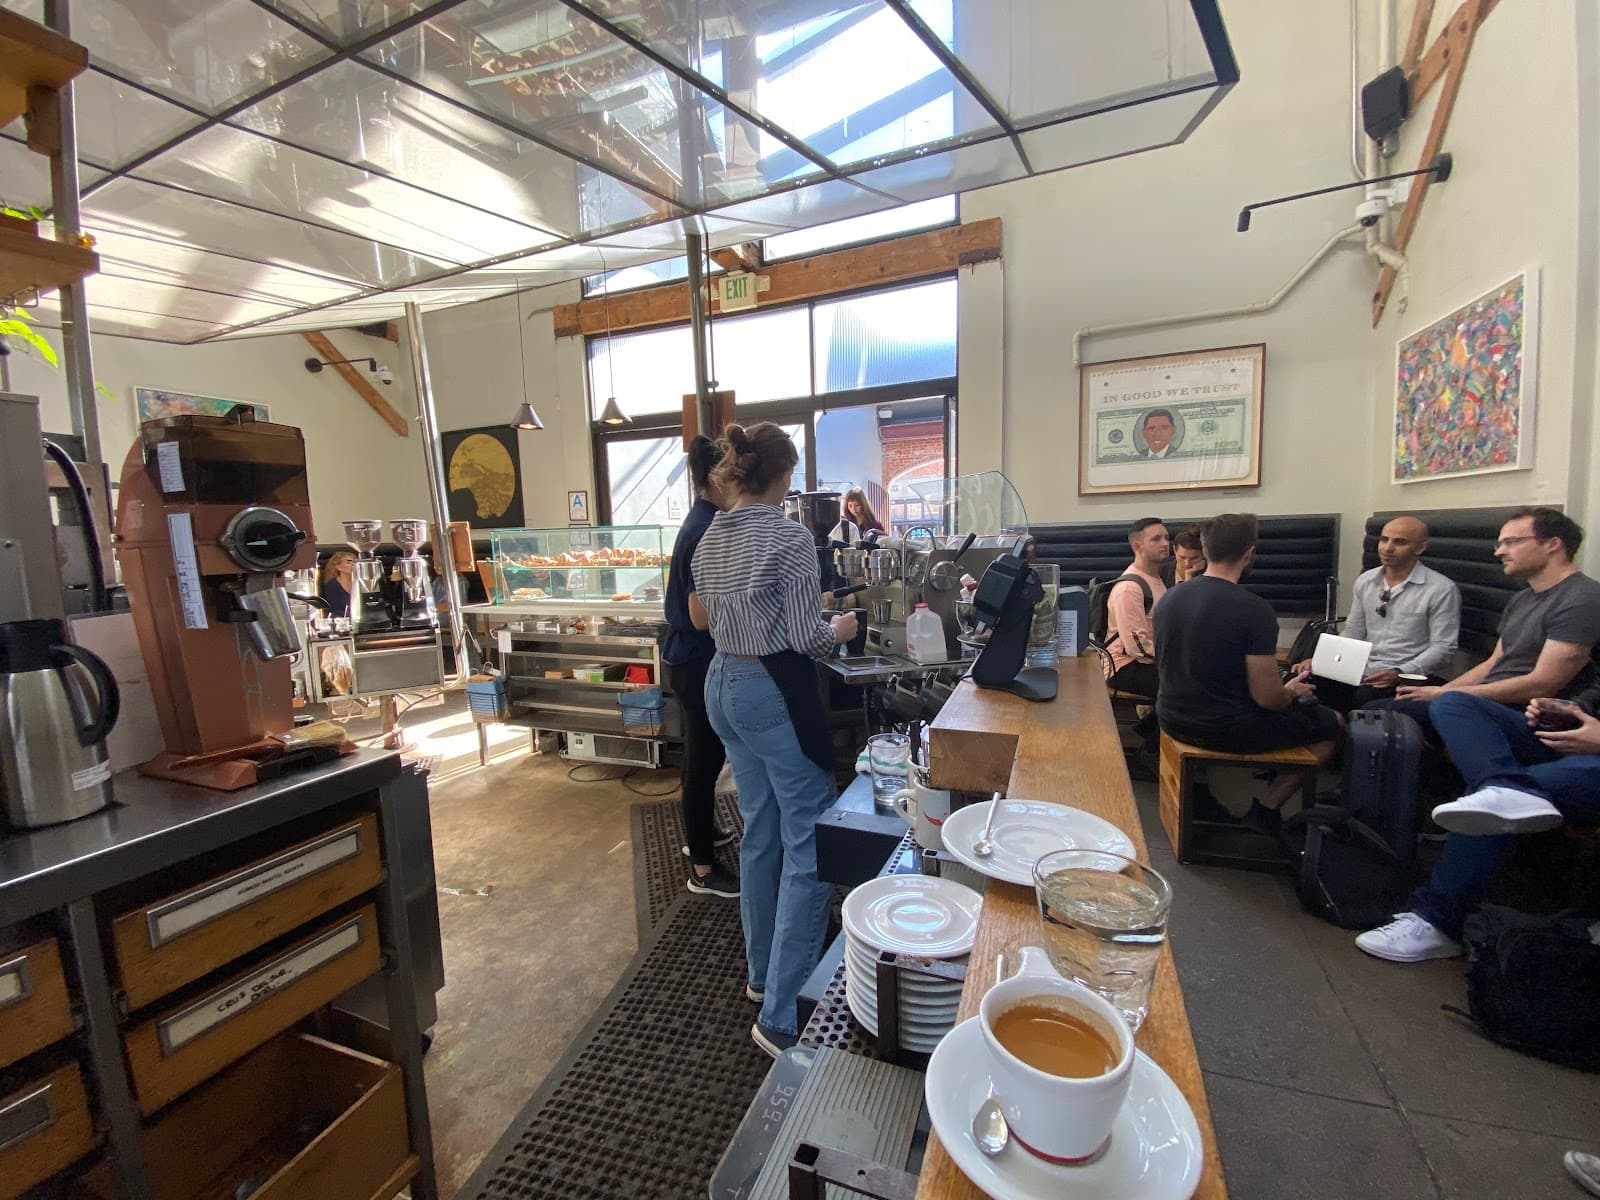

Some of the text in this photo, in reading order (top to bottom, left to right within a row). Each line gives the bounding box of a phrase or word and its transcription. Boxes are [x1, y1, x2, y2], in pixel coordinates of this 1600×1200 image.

[725, 276, 749, 301] EXIT
[1103, 383, 1241, 404] IN GOOD WE TRUST
[573, 494, 583, 508] A
